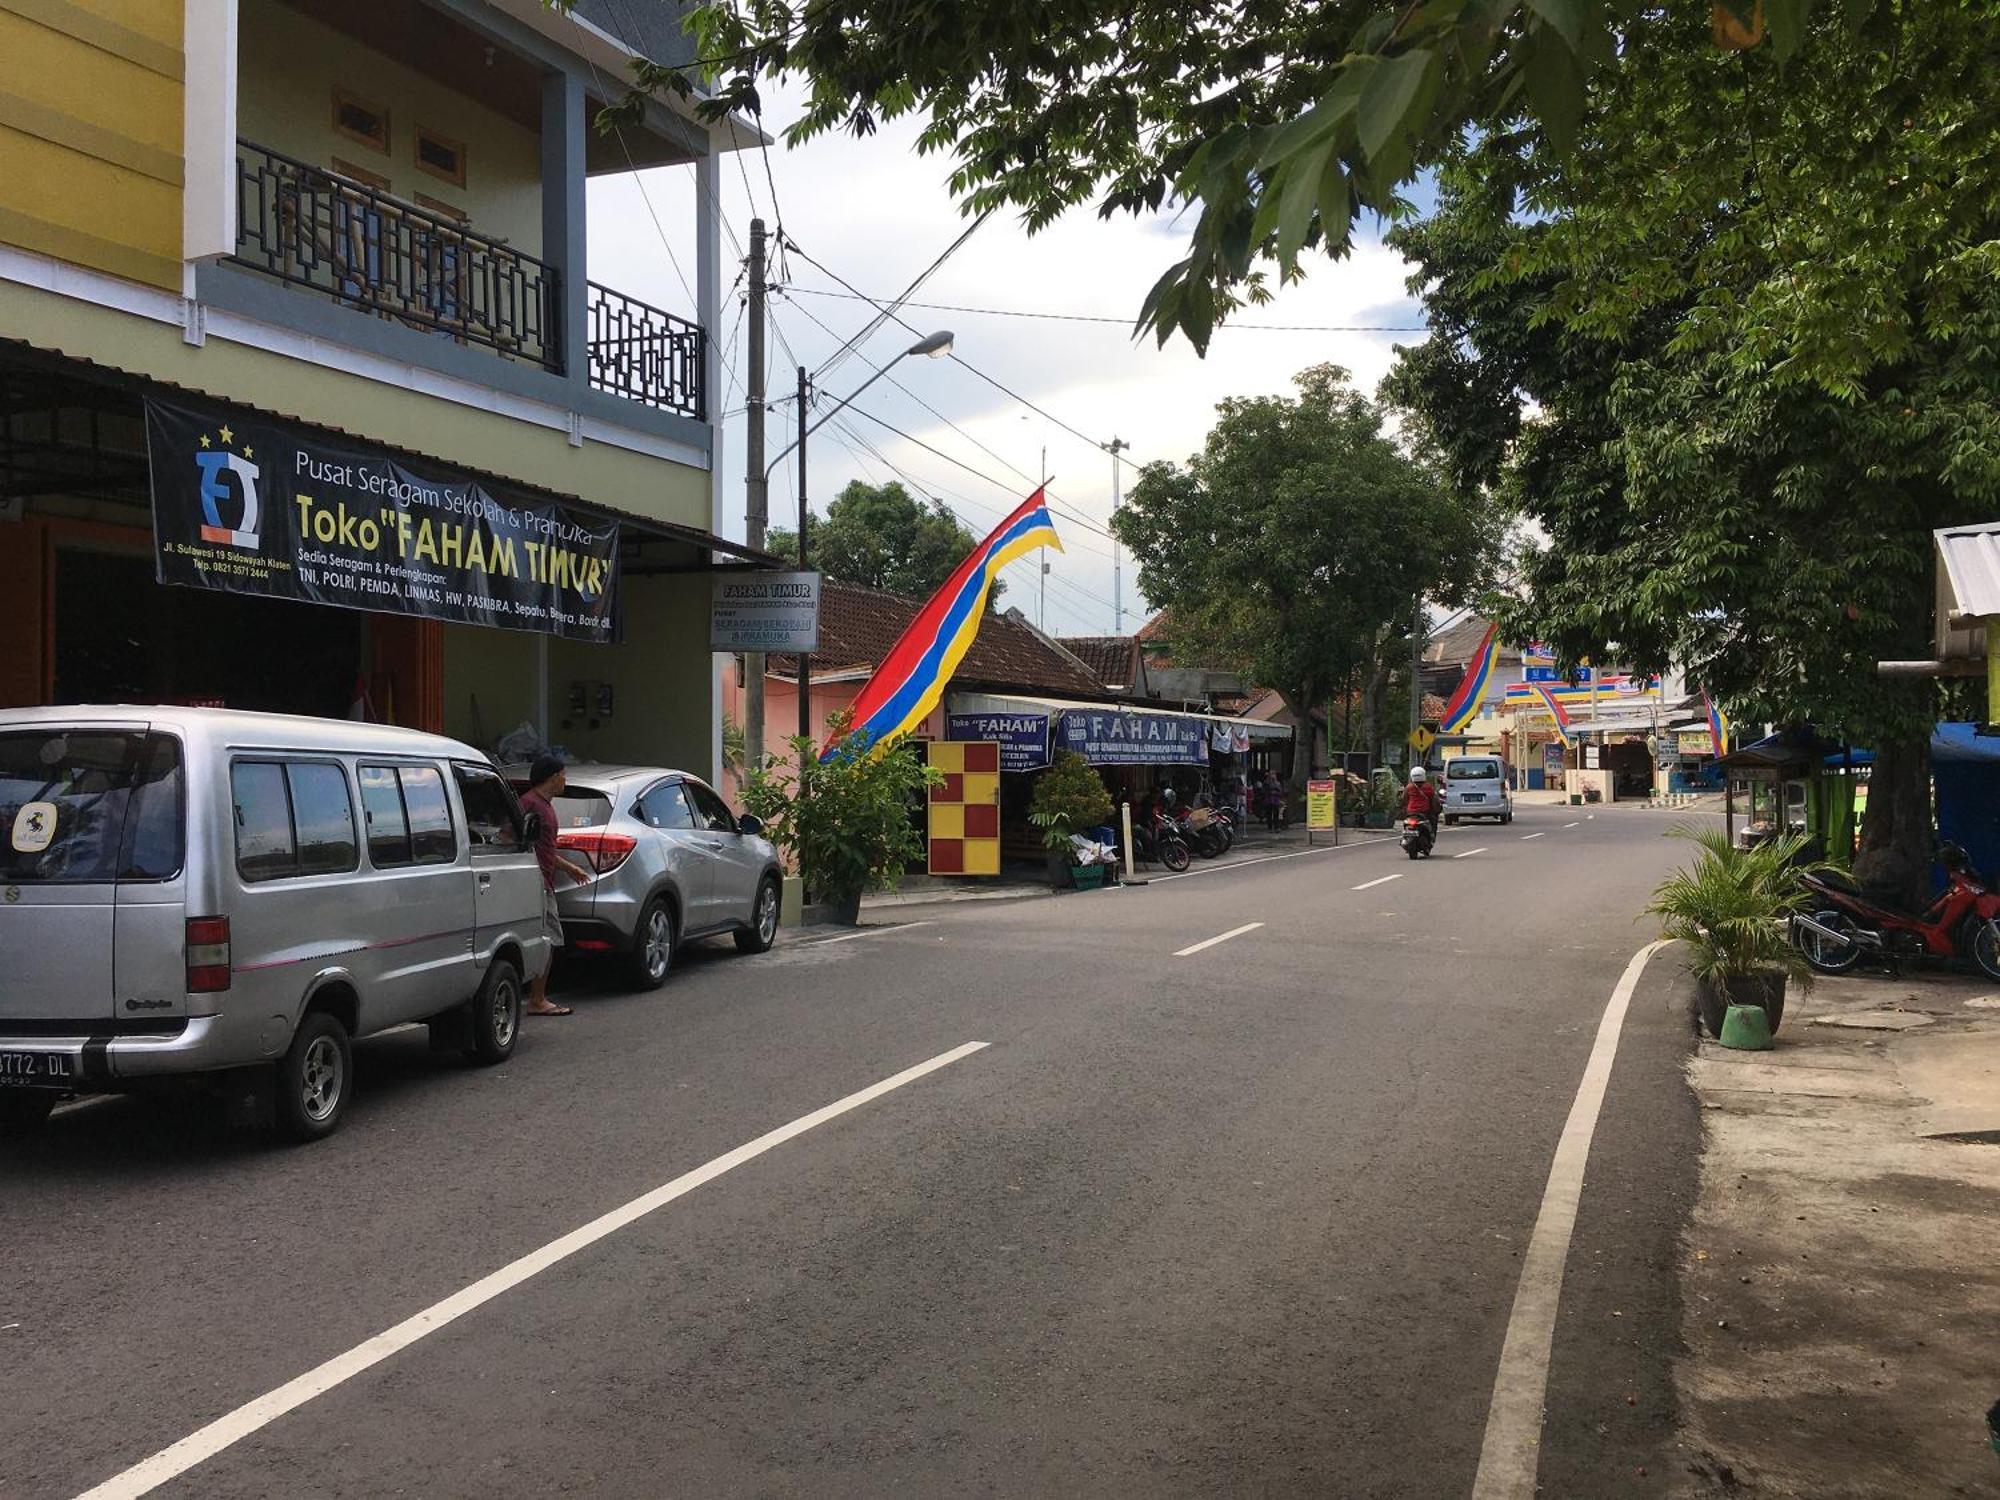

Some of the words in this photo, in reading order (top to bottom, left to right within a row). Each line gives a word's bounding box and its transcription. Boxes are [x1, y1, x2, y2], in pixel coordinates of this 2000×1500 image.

[296, 451, 353, 488] Pusat
[358, 467, 440, 508] Seragam
[444, 489, 505, 525] Sekolah
[508, 508, 520, 528] &
[296, 494, 380, 551] Toko
[163, 542, 175, 553] Jl.
[177, 543, 214, 558] Sulawesi
[215, 550, 225, 560] 19
[227, 551, 266, 566] Sidowayah
[267, 558, 291, 570] Klaten
[193, 558, 211, 571] Telp.
[212, 563, 231, 573] 0821
[250, 567, 269, 579] 2444
[298, 547, 328, 565] Sedia
[329, 553, 373, 573] Seragam
[375, 562, 382, 574] &
[298, 567, 320, 586] TNI,
[323, 571, 357, 592] POLRI,
[360, 577, 402, 597] PEMDA,
[404, 584, 443, 604] LINMAS,
[514, 601, 549, 619] Sepatu,
[723, 583, 768, 598] FAHAM
[770, 583, 811, 598] TIMUR
[972, 719, 1044, 733] "FAHAM"
[1092, 716, 1178, 741] FAHAM
[48, 1055, 70, 1076] DL
